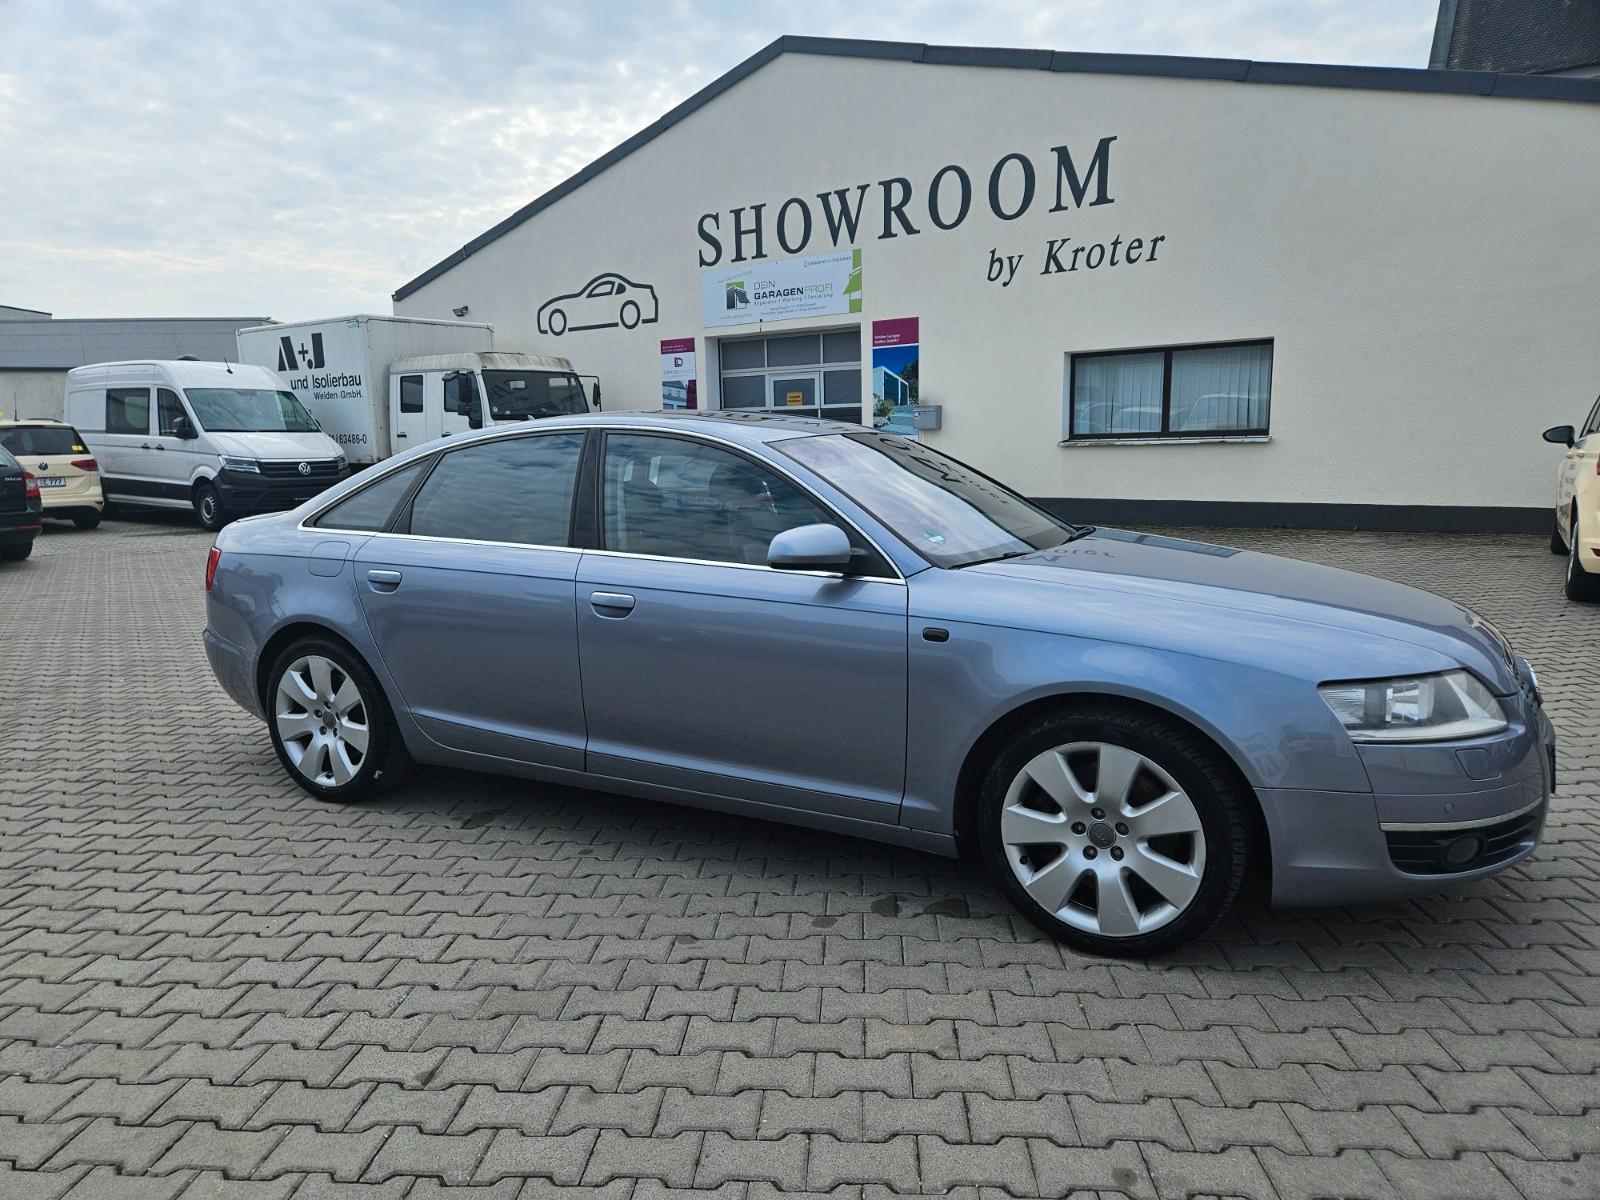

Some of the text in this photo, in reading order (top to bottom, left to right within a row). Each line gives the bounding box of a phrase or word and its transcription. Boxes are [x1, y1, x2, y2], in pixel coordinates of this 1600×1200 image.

[697, 135, 1118, 268] SHOWROOM
[986, 233, 1166, 288] by Kroter
[753, 280, 776, 291] DEIN
[754, 282, 833, 300] GARAGENPROFI
[290, 372, 362, 390] und Isolierbau
[313, 391, 339, 401] Weiden
